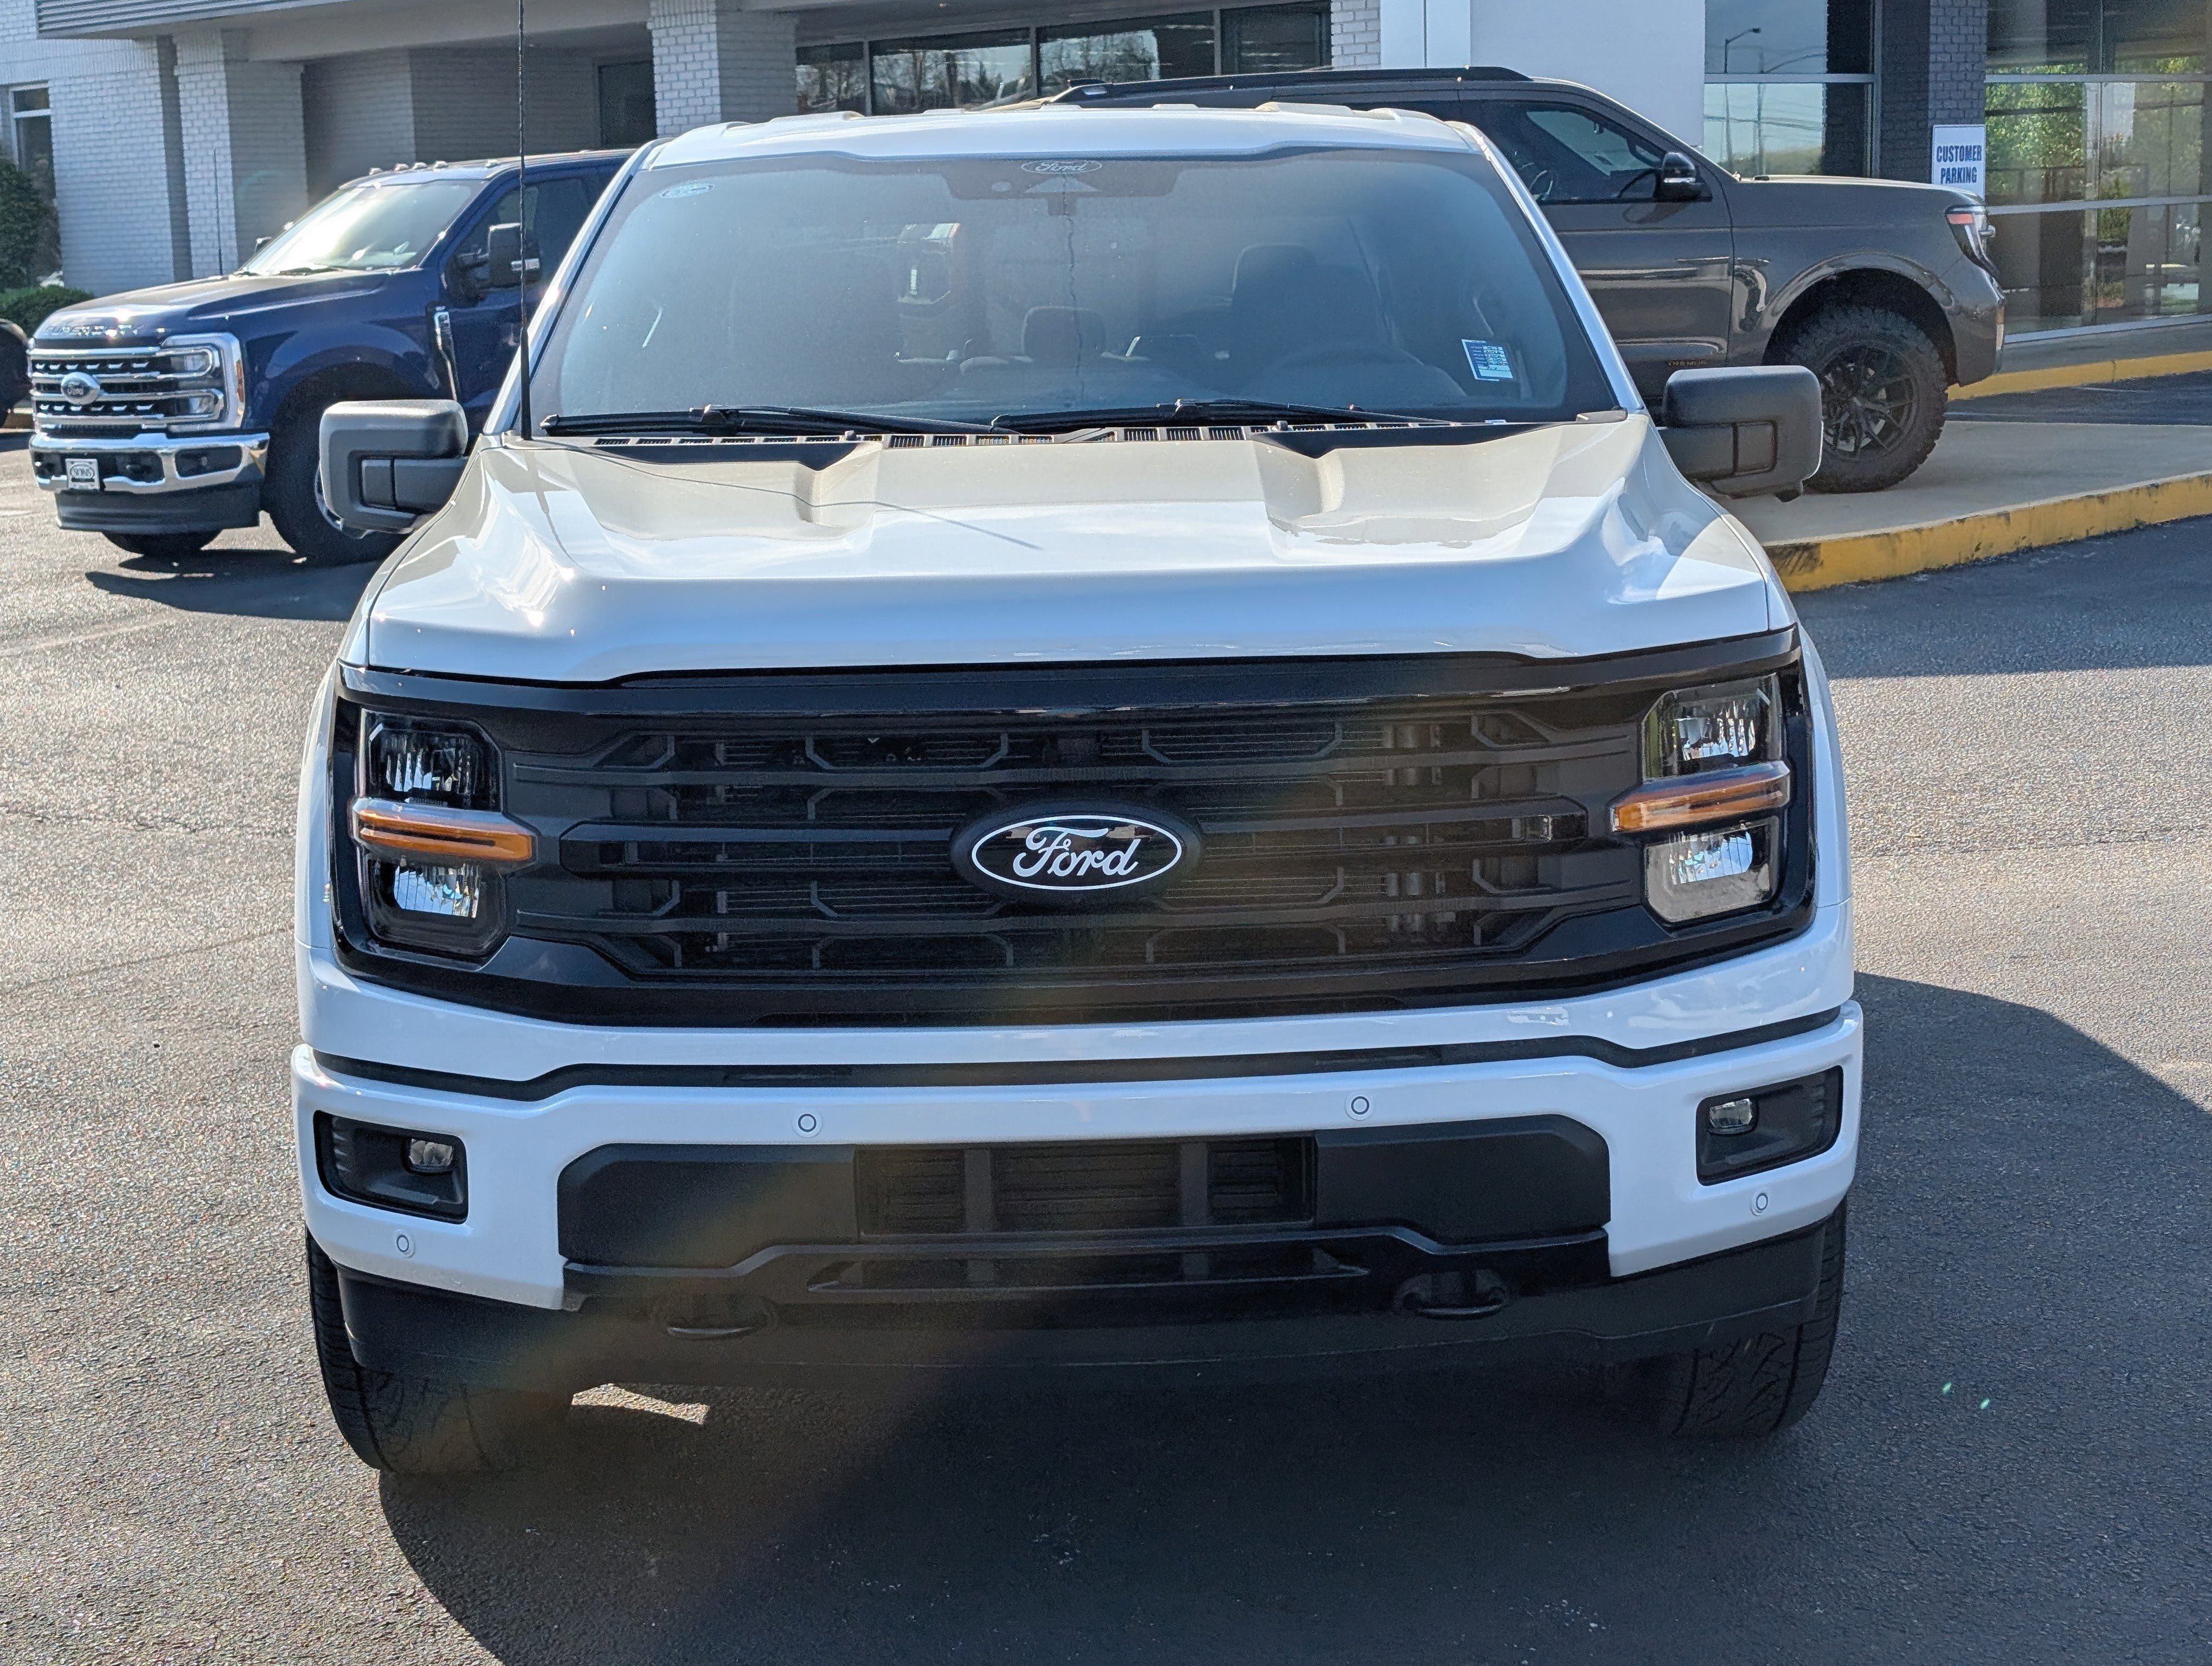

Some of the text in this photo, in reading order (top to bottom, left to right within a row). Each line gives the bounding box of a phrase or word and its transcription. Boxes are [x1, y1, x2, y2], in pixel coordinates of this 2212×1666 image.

[1936, 145, 1982, 162] CUSTOMER
[1035, 159, 1088, 171] Ford
[1940, 166, 1977, 184] PARKING
[1013, 826, 1141, 877] Ford
